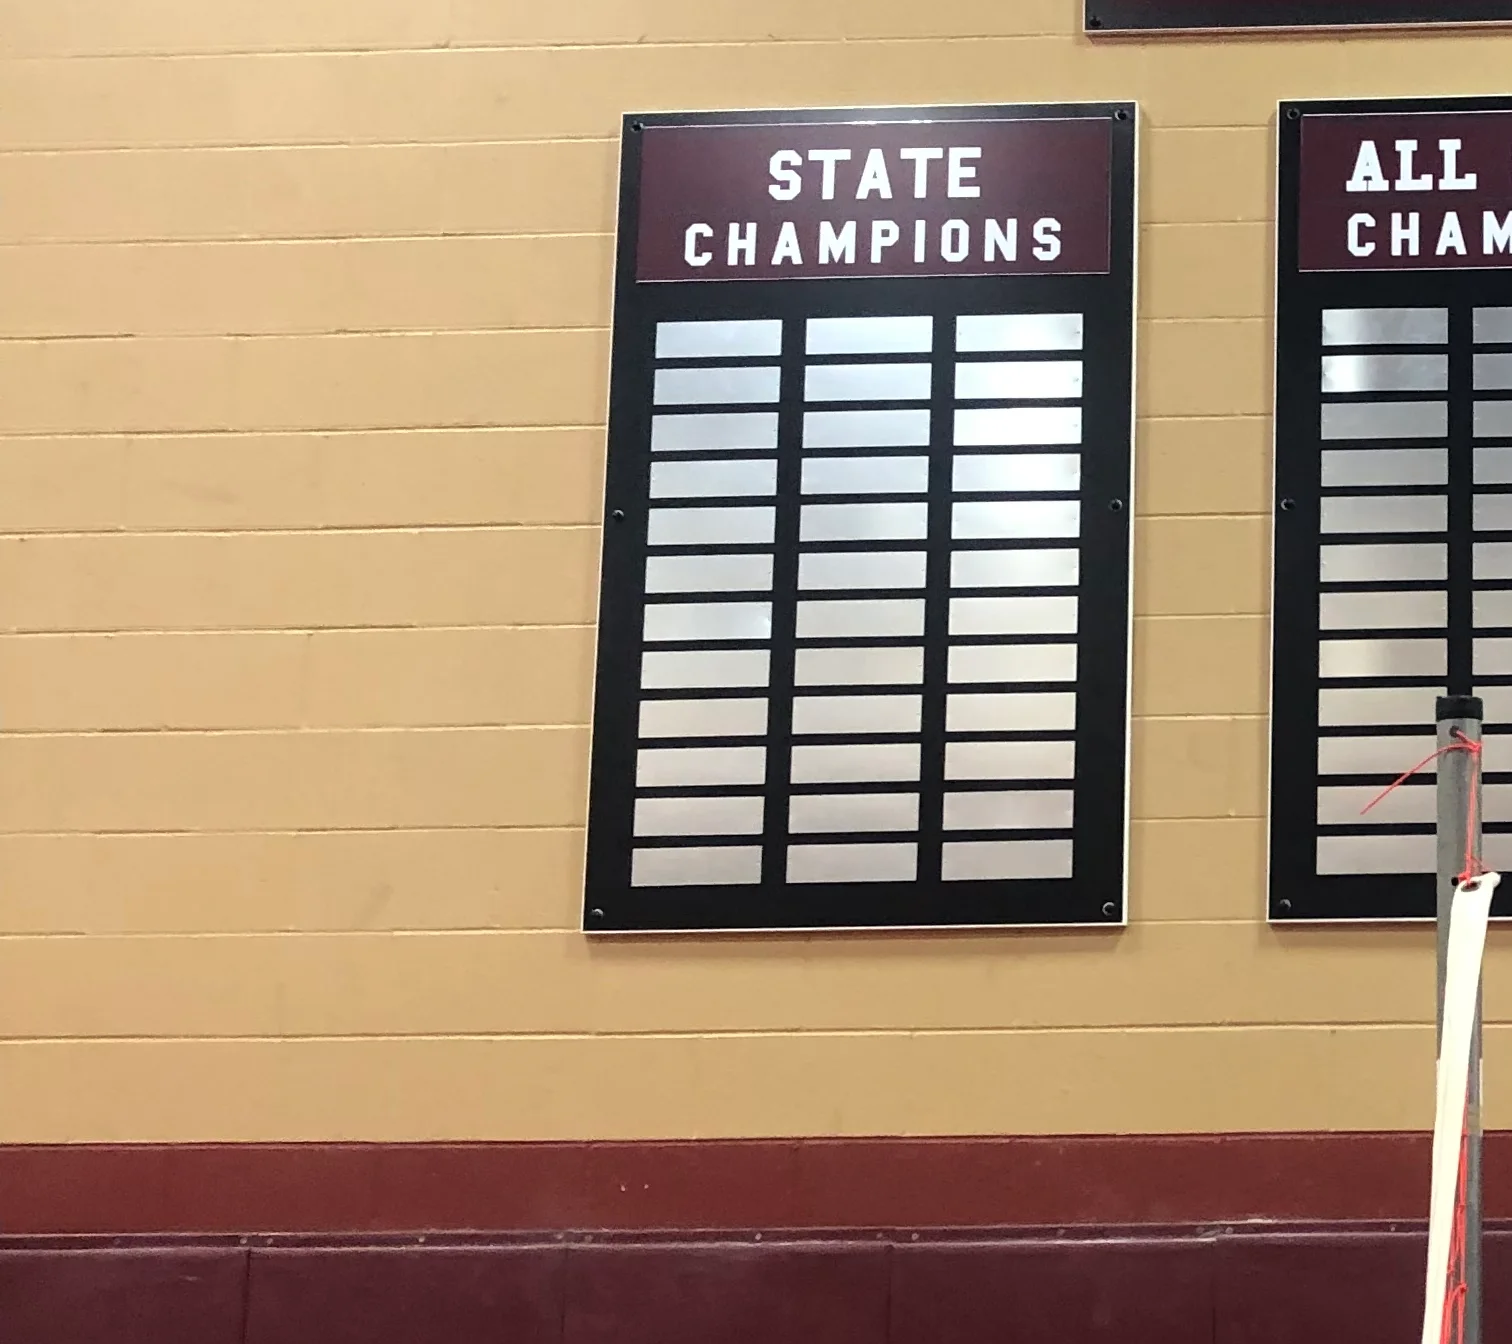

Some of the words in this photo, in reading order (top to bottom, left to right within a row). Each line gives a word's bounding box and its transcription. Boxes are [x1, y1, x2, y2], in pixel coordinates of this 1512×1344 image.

[767, 146, 982, 201] STATE
[1345, 138, 1477, 192] ALL
[684, 217, 1062, 267] CHAMPIONS
